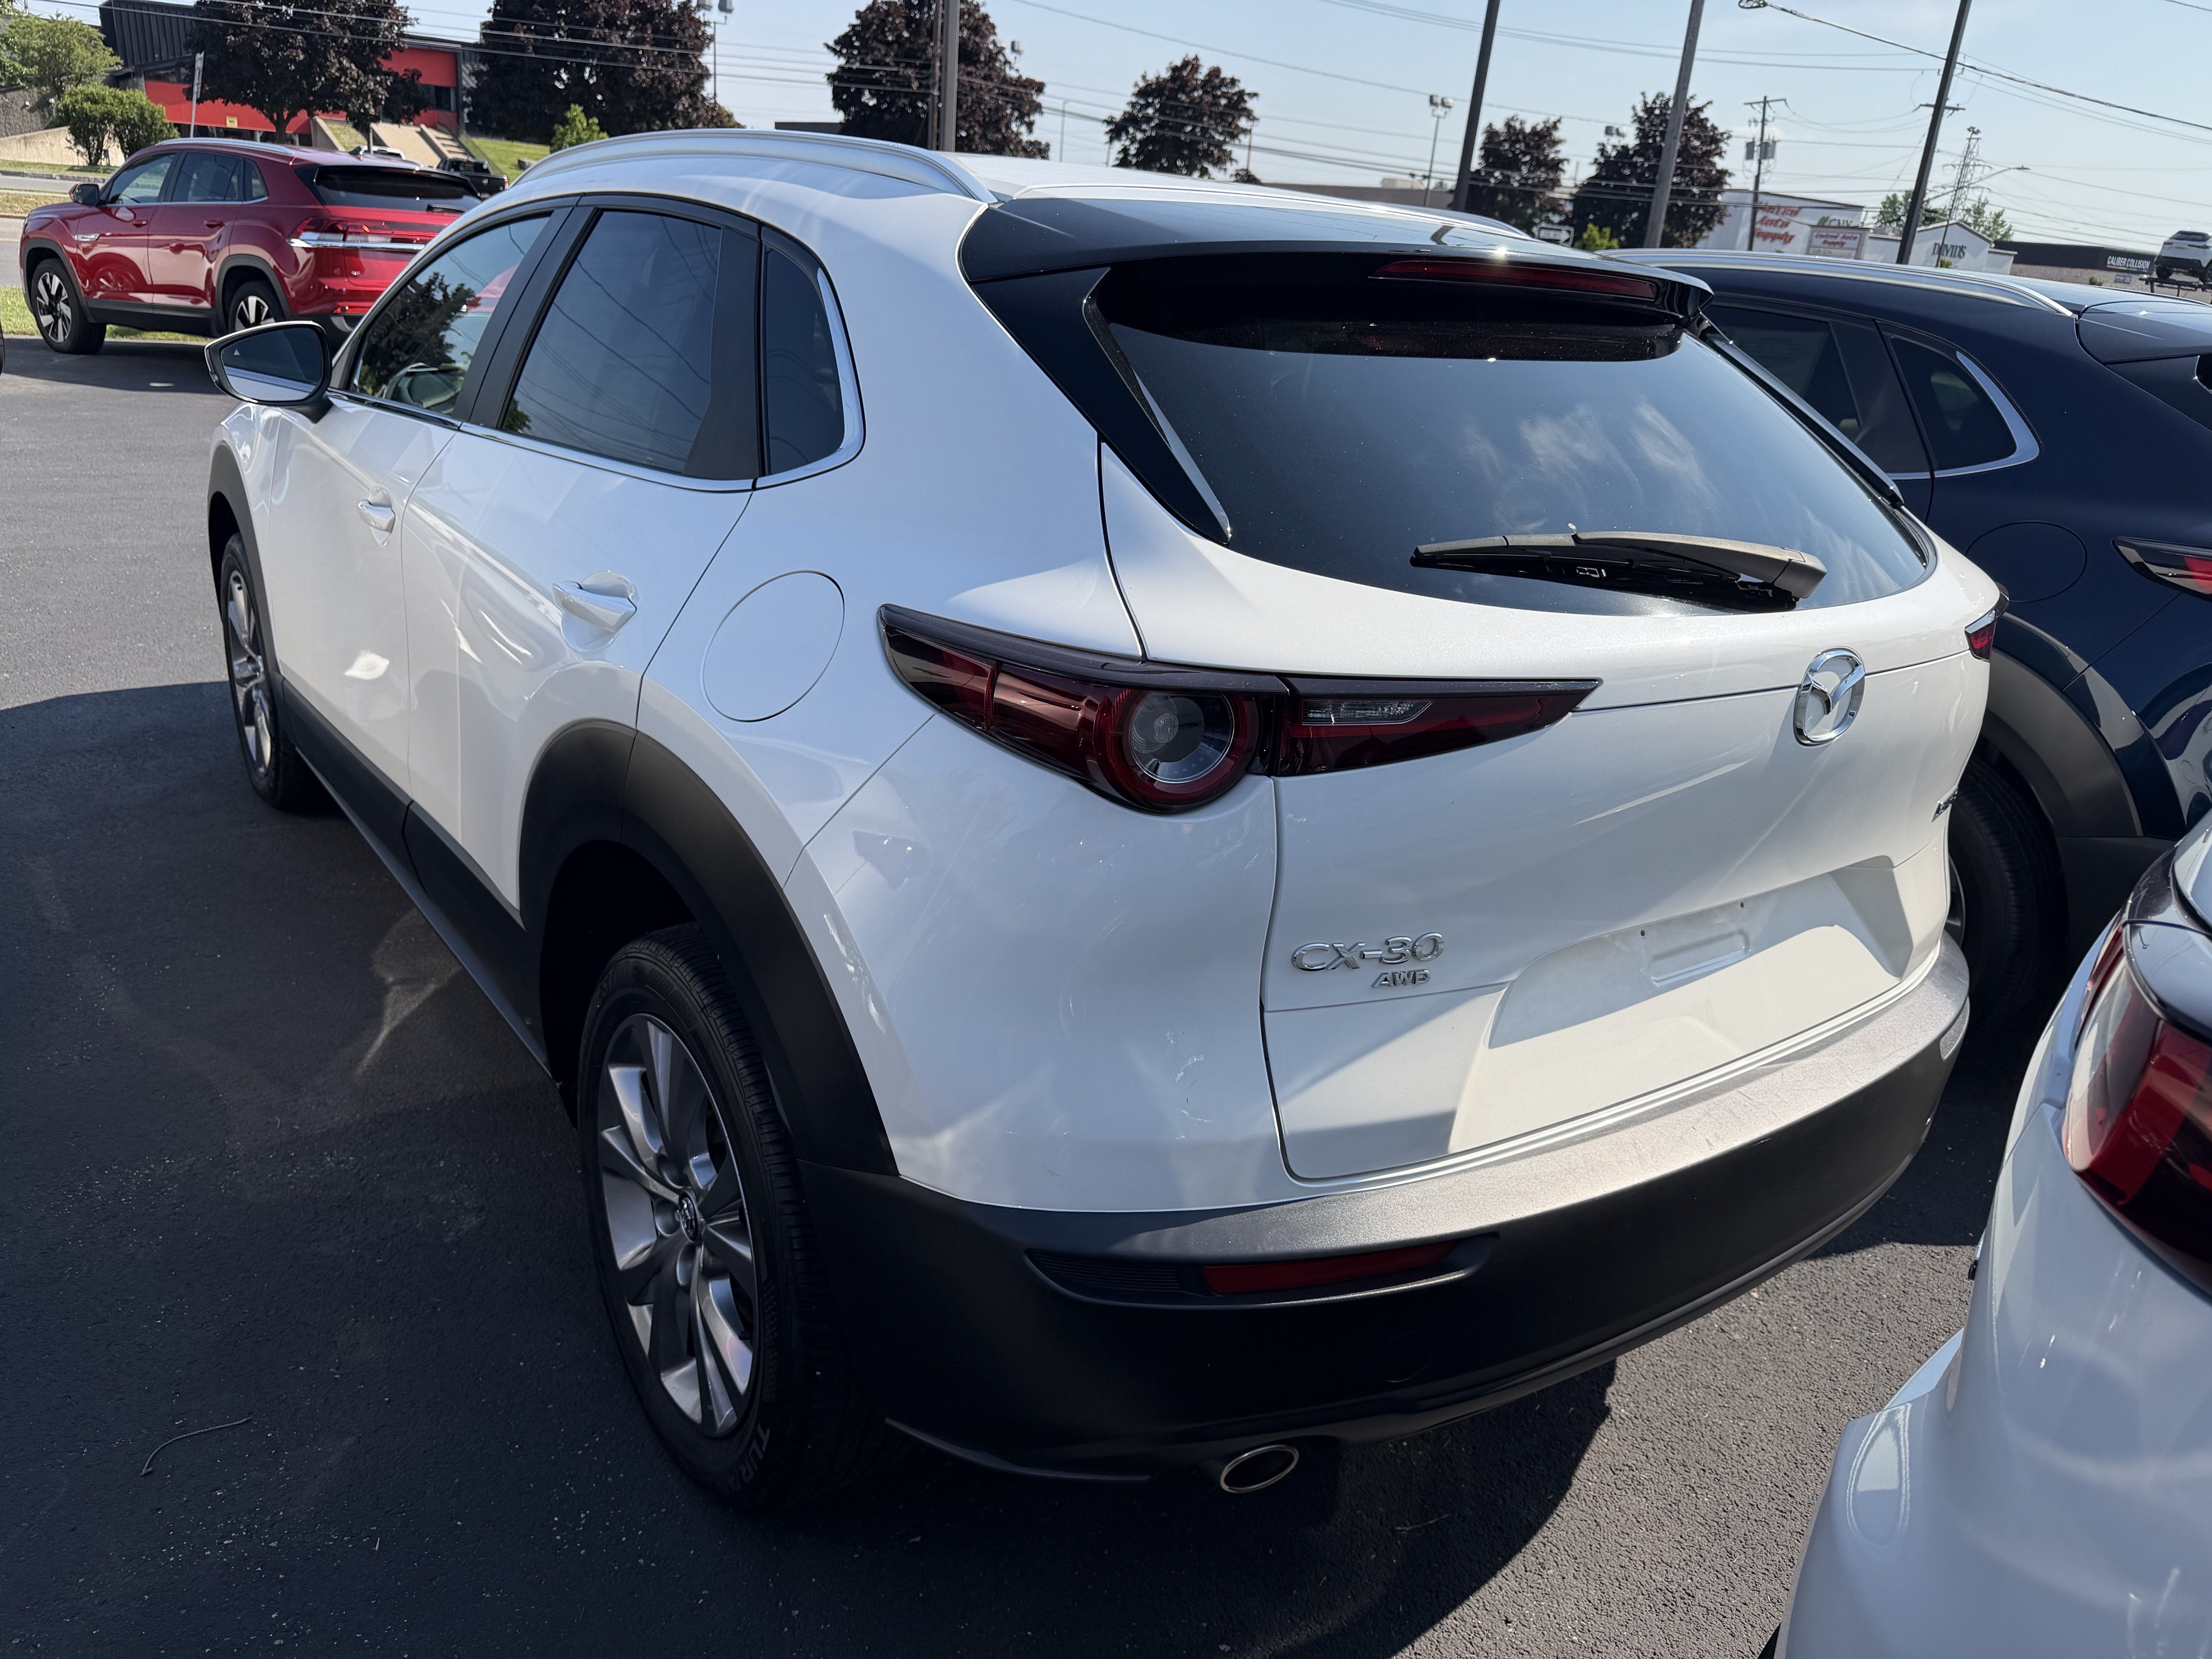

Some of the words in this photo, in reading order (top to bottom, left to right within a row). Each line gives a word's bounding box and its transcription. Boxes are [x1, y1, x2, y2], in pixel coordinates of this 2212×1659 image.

[1755, 214, 1791, 228] Auto
[2107, 256, 2127, 266] CALIBER
[2126, 258, 2151, 270] COLLISION
[1291, 932, 1445, 971] CX-30
[1372, 969, 1431, 988] AWD
